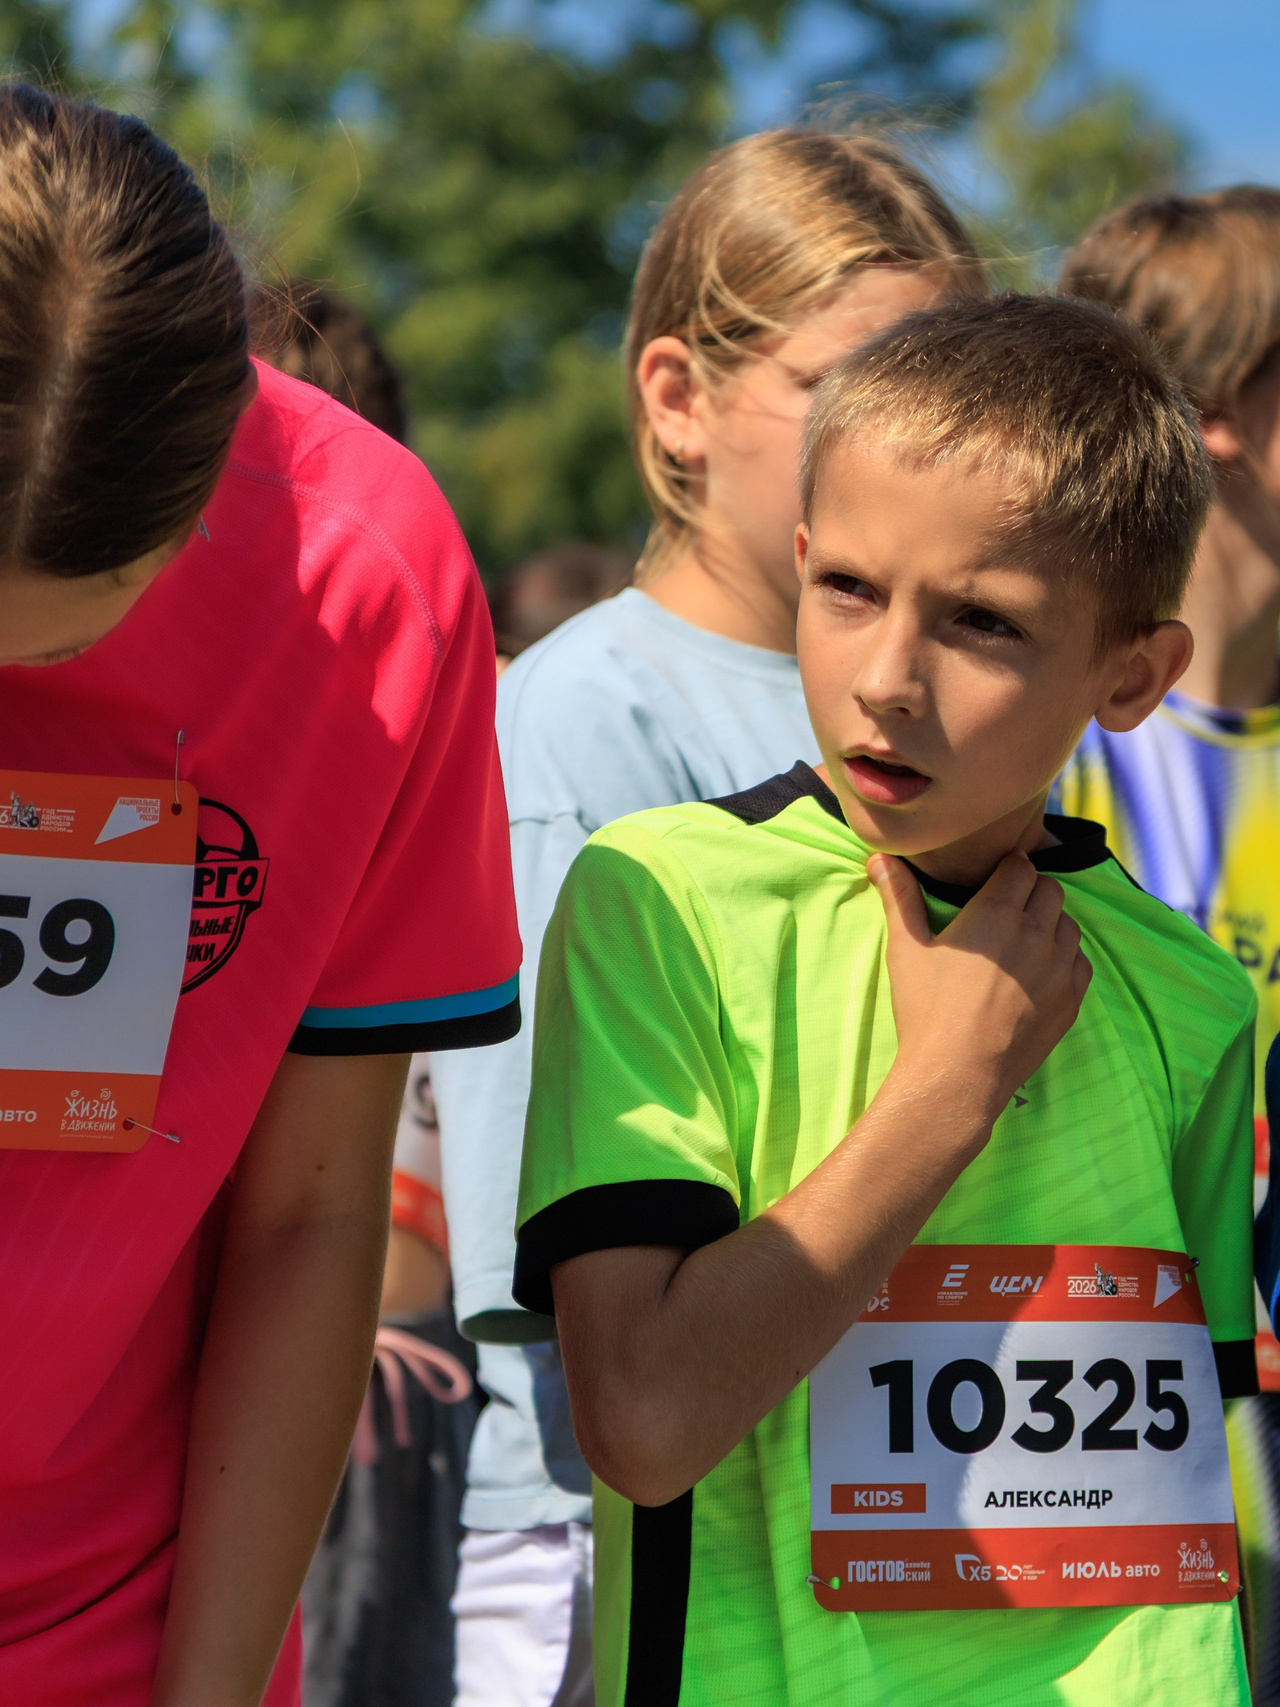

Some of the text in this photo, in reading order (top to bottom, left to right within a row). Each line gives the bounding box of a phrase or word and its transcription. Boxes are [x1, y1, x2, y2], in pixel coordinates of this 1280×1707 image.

[41, 814, 74, 822] ЕДИНСТВА
[64, 1095, 117, 1120] ЖИЗНЬ
[0, 1110, 37, 1123] вто
[60, 1119, 116, 1132] В ДВИЖЕНИИ
[1067, 1280, 1097, 1294] 2026
[869, 1358, 1190, 1454] 10325
[854, 1490, 903, 1507] KIDS
[984, 1489, 1113, 1509] АЛЕКСАНДР
[1177, 1548, 1215, 1570] ЖИЗНЬ
[1062, 1561, 1160, 1579] ИЮЛЬ авто
[1183, 1571, 1216, 1582] ДВИЖЕНИИ
